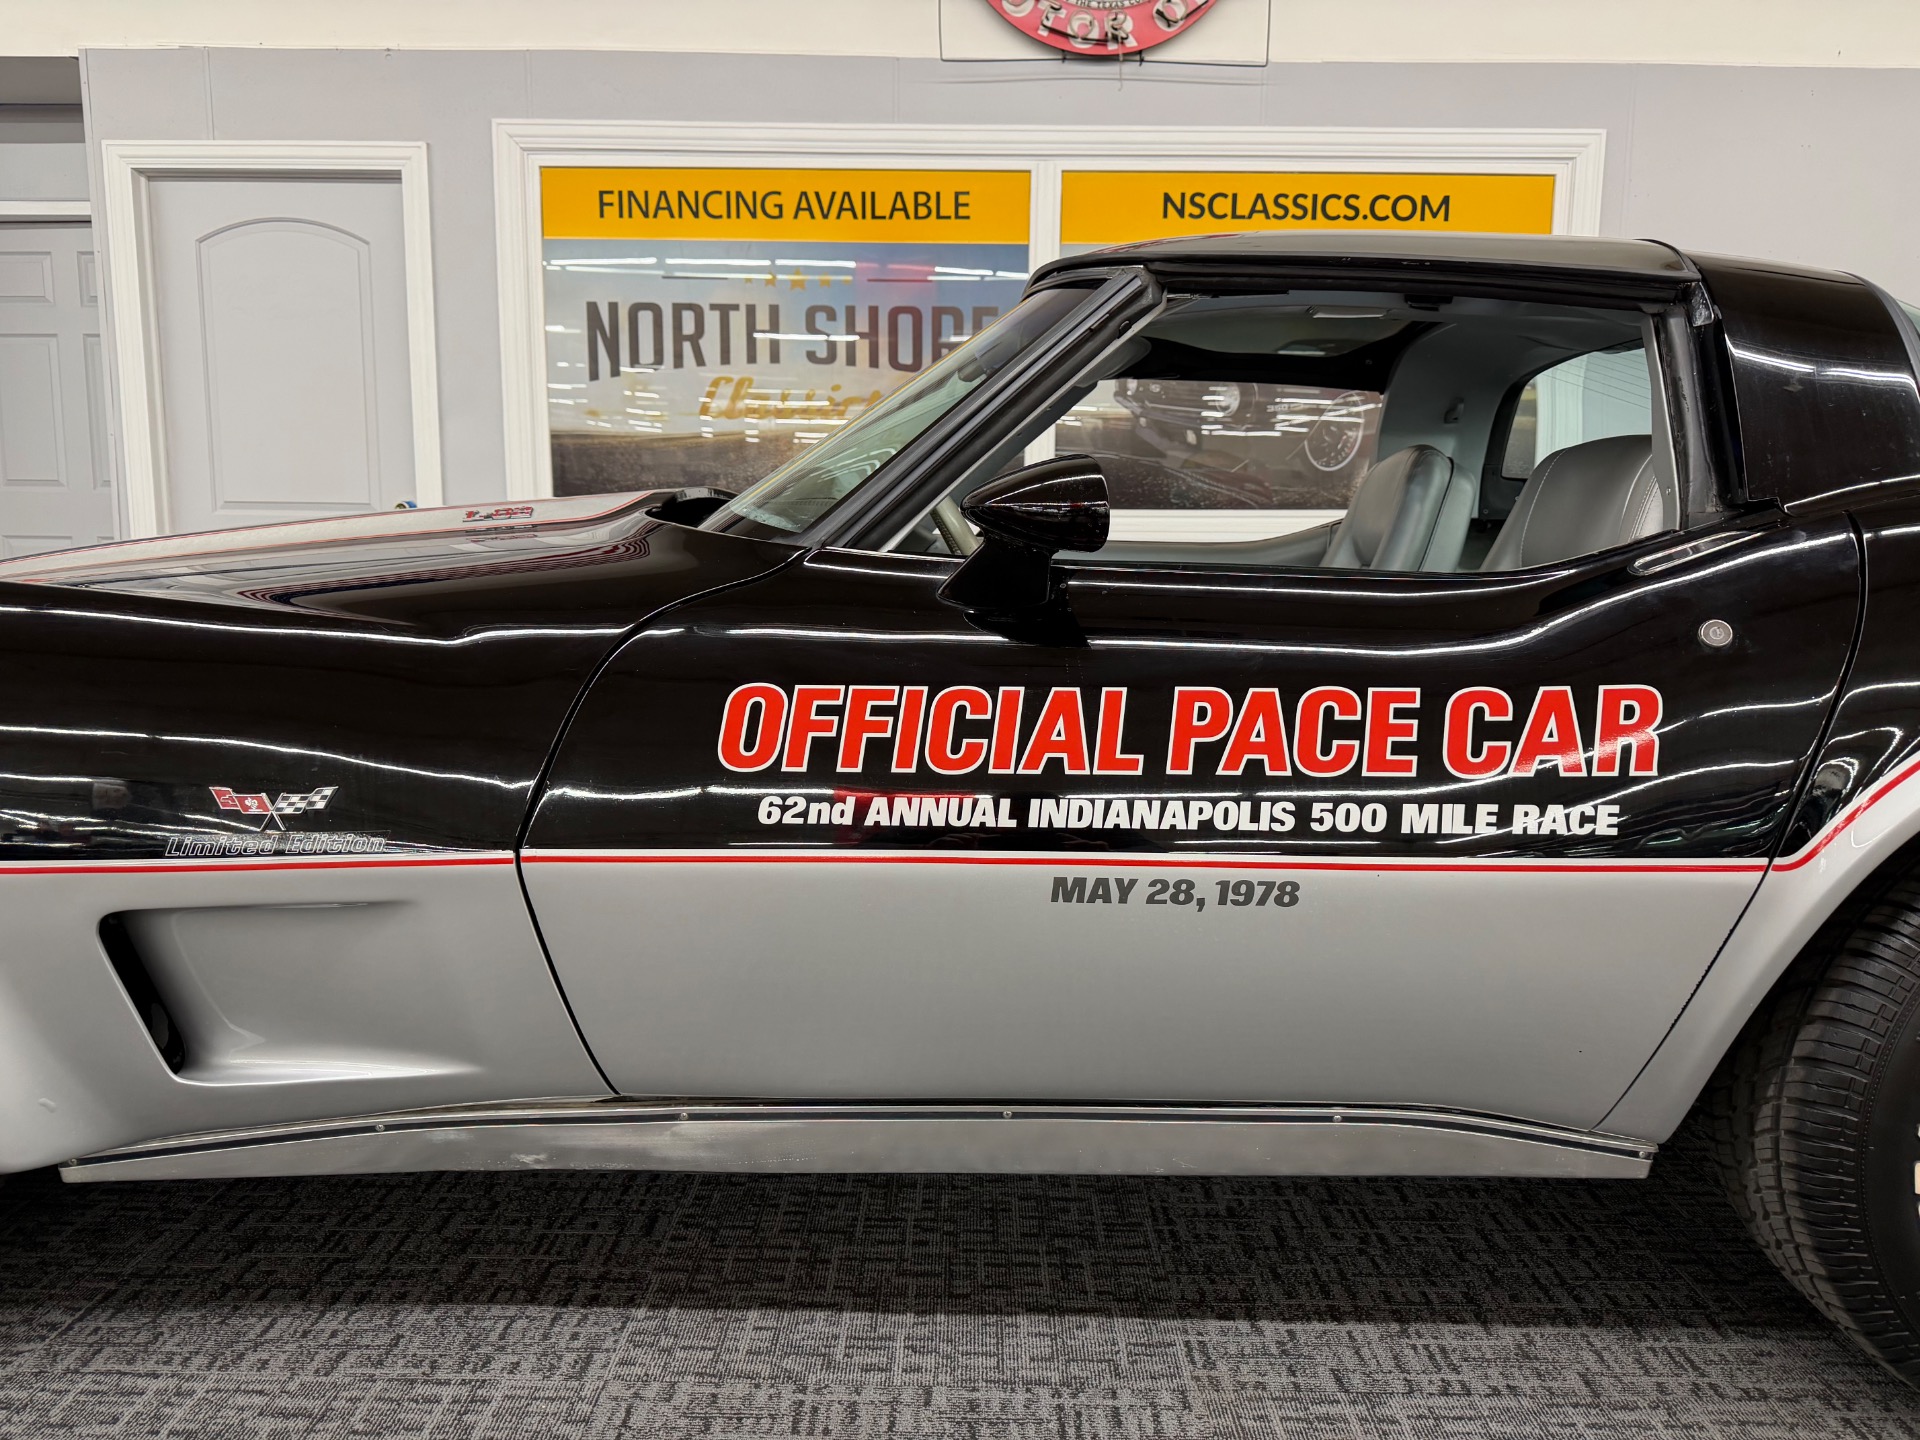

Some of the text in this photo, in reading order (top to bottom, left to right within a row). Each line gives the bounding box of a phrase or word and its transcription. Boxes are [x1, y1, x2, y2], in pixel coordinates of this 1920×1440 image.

[599, 190, 971, 220] FINANCING AVAILABLE
[1162, 192, 1451, 222] NSCLASSICS.COM
[586, 301, 781, 382] NORTH
[717, 682, 1664, 779] OFFICIAL PACE CAR
[757, 796, 1620, 836] 62nd ANNUAL INDIANAPOLIS 500 MILE RACE
[165, 834, 386, 857] Limited Edition
[1050, 876, 1301, 912] MAY 28, 1978
